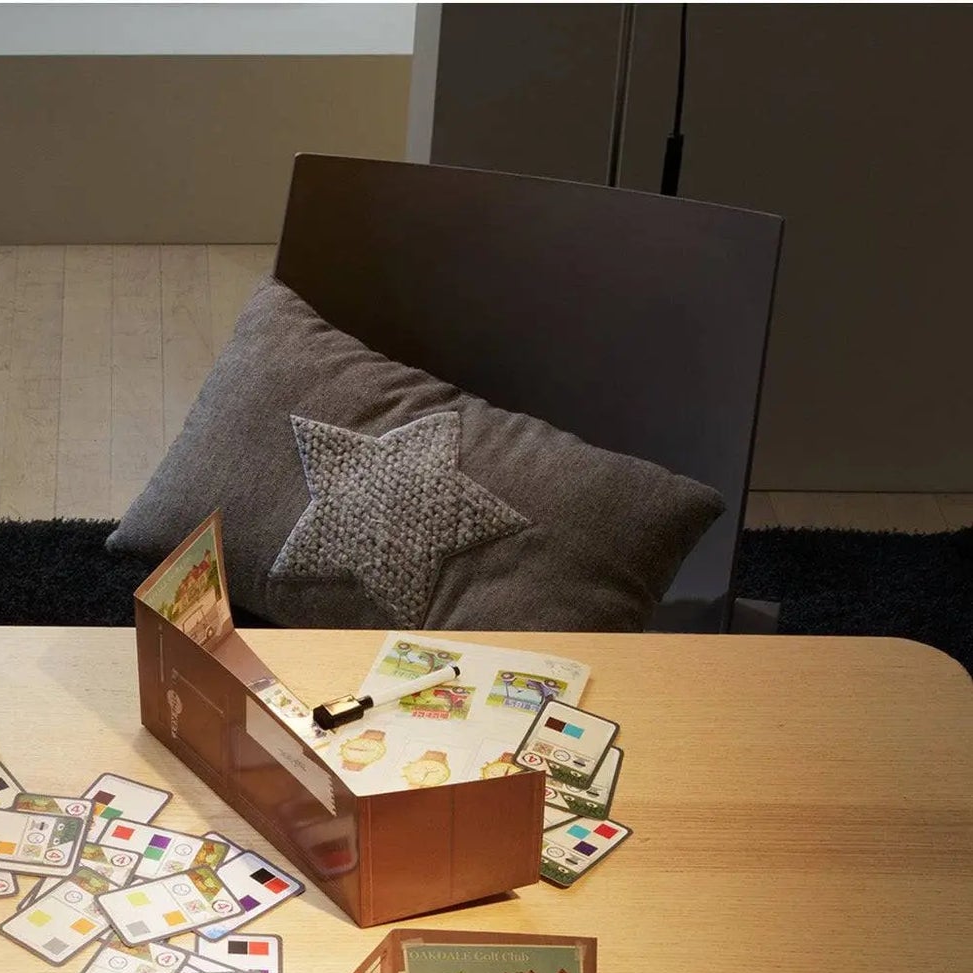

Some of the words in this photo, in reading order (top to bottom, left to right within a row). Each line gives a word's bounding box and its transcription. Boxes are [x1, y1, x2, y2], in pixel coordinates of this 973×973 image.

[410, 951, 469, 962] OAKDALE
[475, 951, 500, 962] Golf
[502, 951, 529, 962] Club
